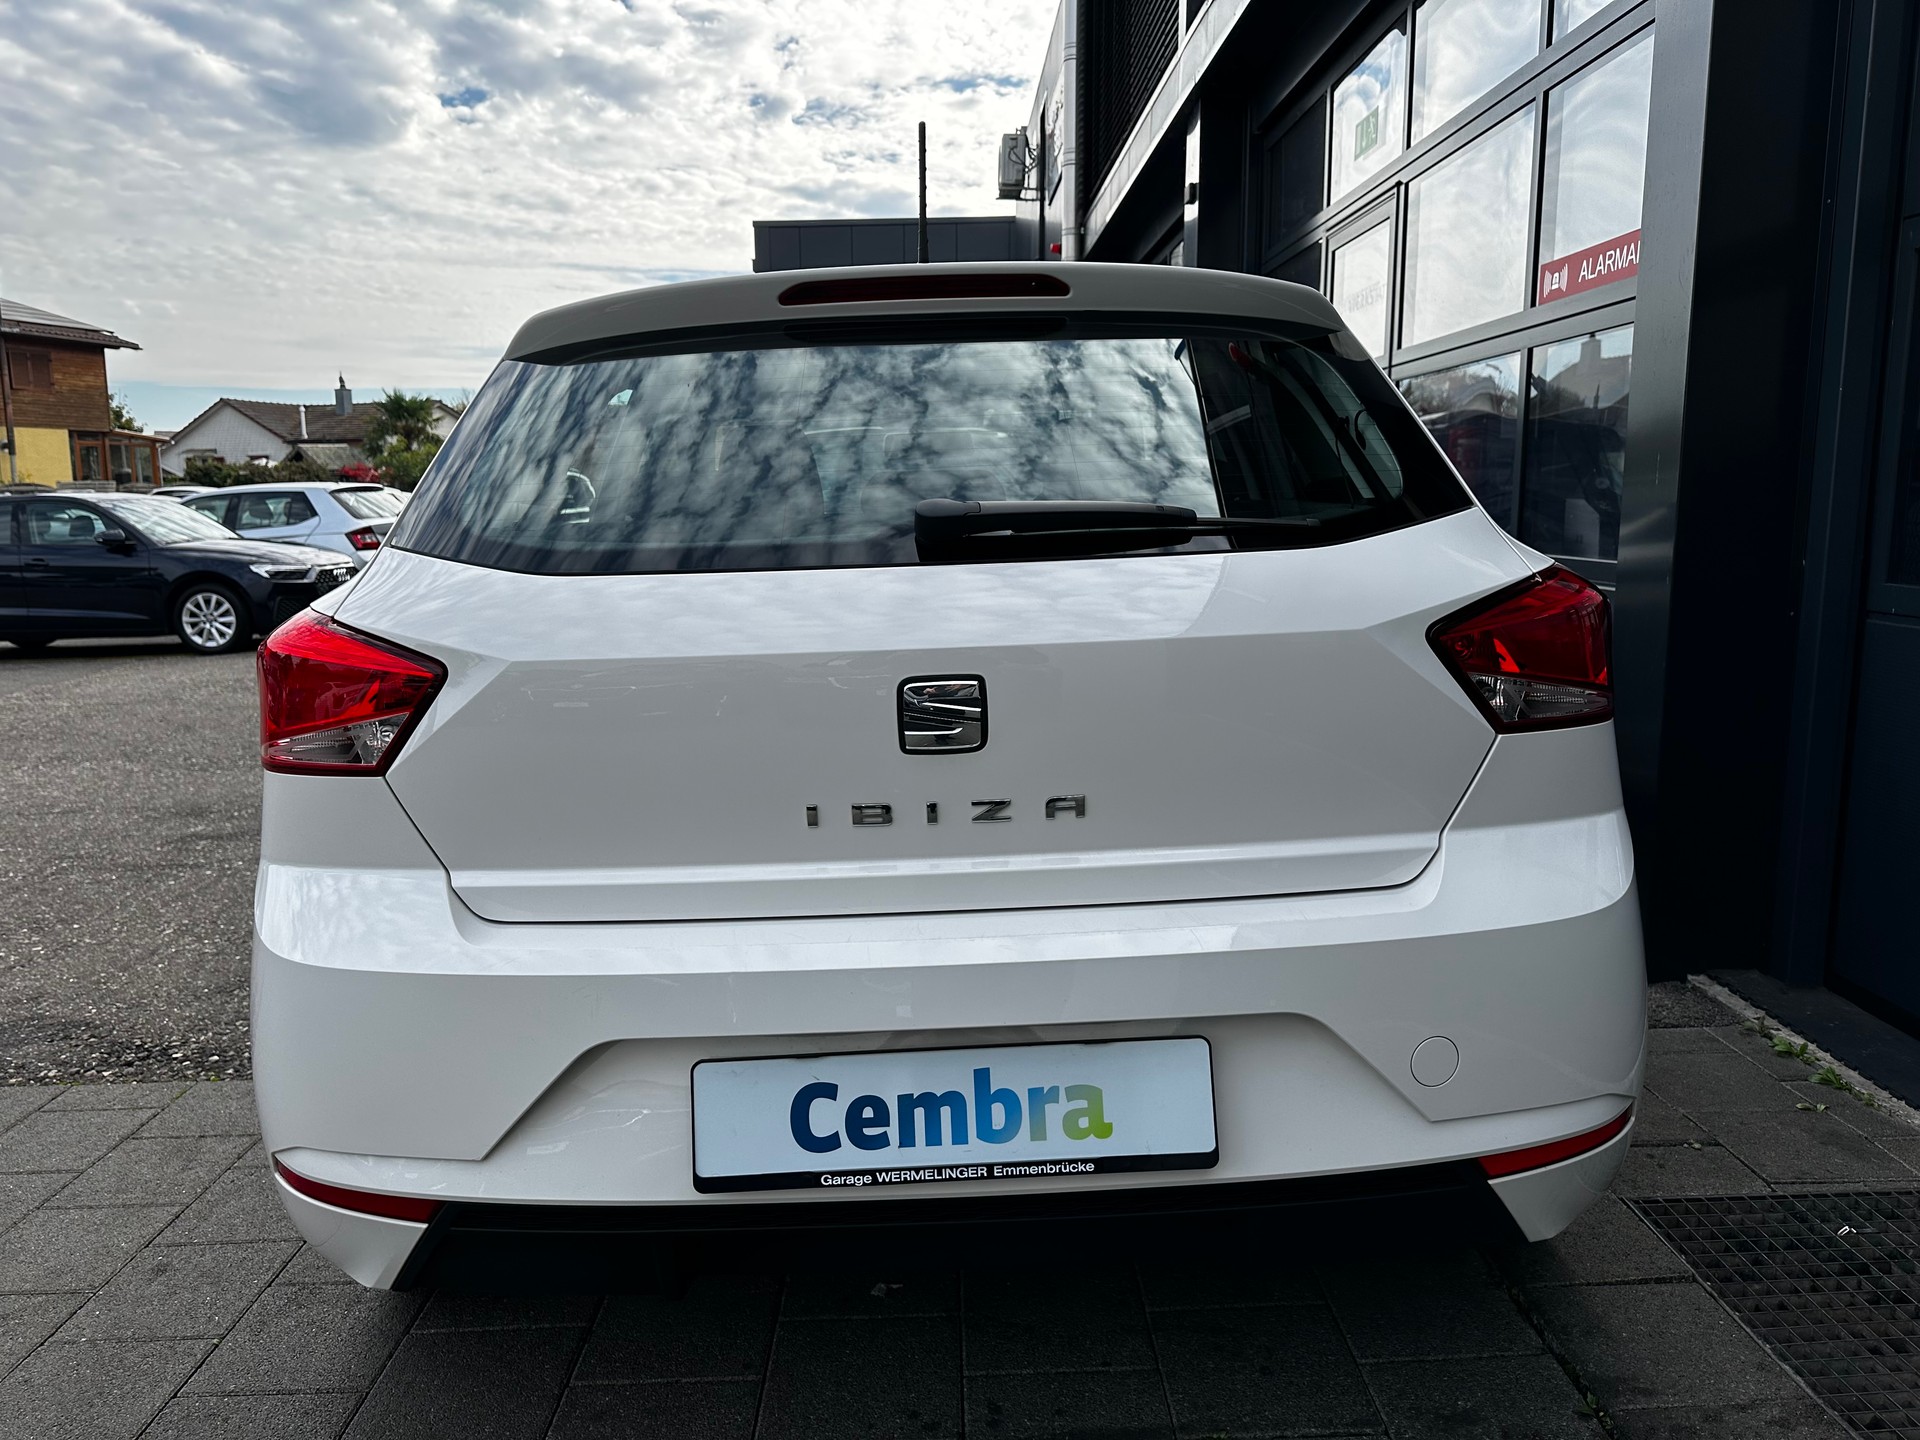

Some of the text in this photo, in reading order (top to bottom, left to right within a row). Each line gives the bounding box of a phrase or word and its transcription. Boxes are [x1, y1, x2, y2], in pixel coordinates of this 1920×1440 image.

[806, 794, 1086, 828] IBIZA
[789, 1067, 1114, 1154] Cembra
[820, 1161, 1095, 1187] Garage WERMELINGER Emmenbrücke
